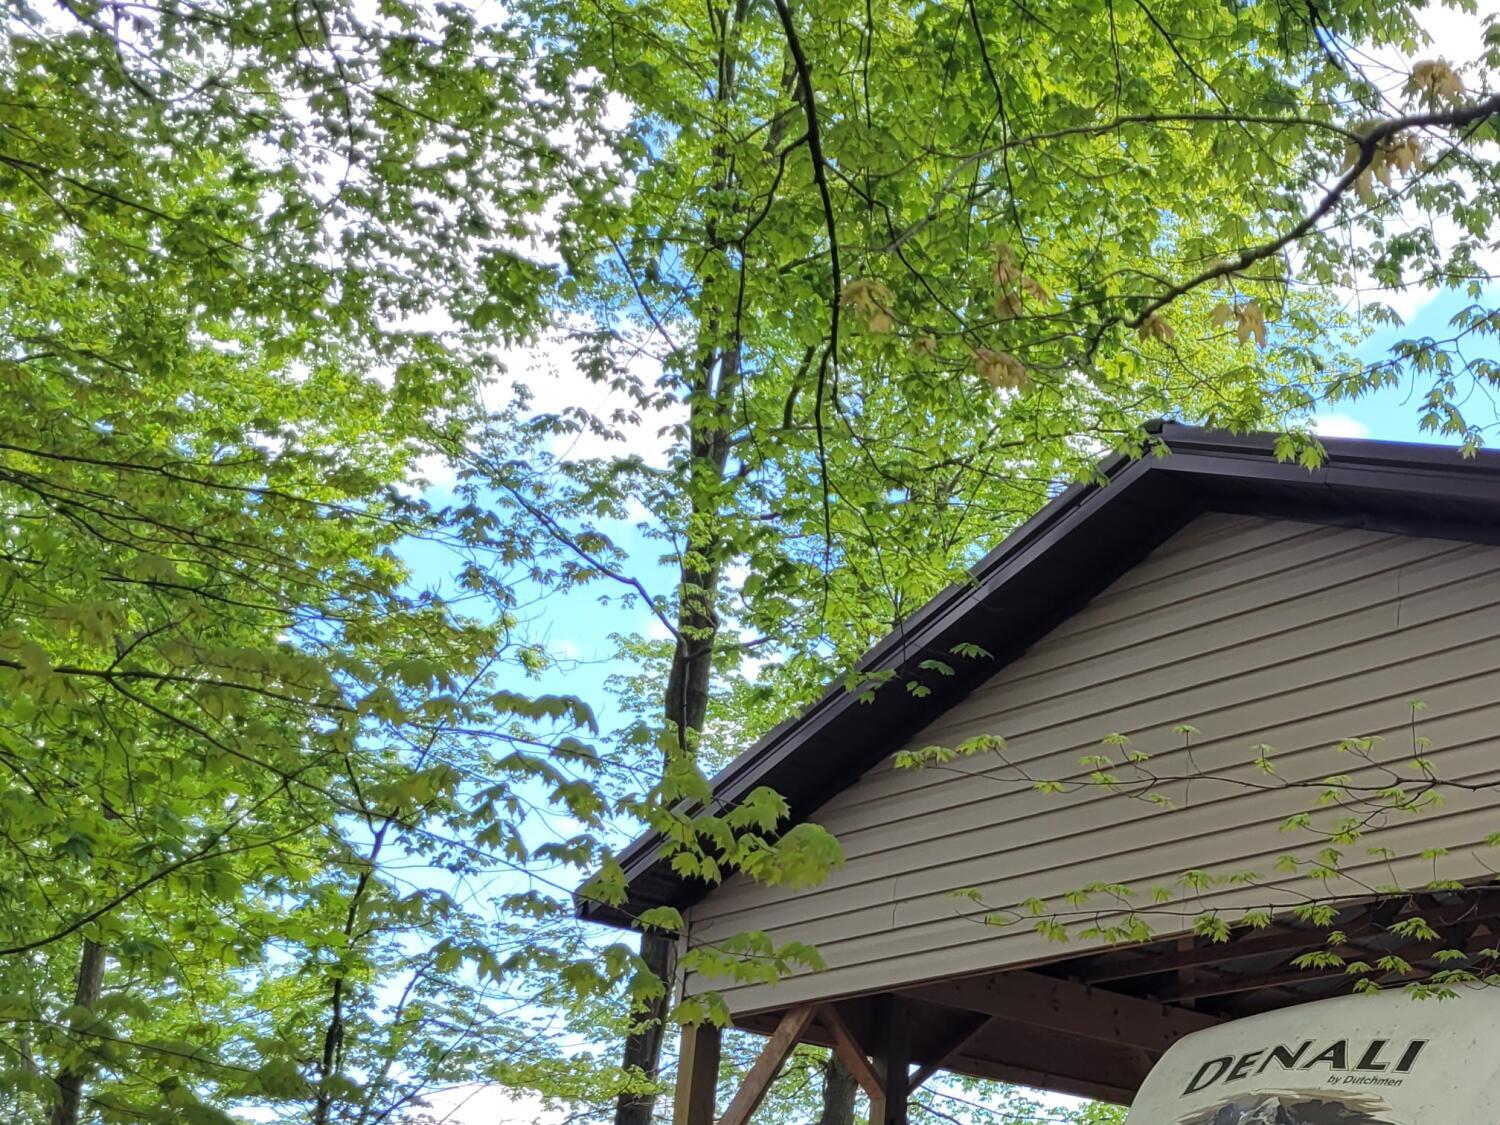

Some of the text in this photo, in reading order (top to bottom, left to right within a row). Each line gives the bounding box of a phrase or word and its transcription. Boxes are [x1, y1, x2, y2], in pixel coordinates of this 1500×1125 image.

[1181, 1038, 1430, 1097] DENALI
[1327, 1074, 1403, 1087] by Dutchmen
